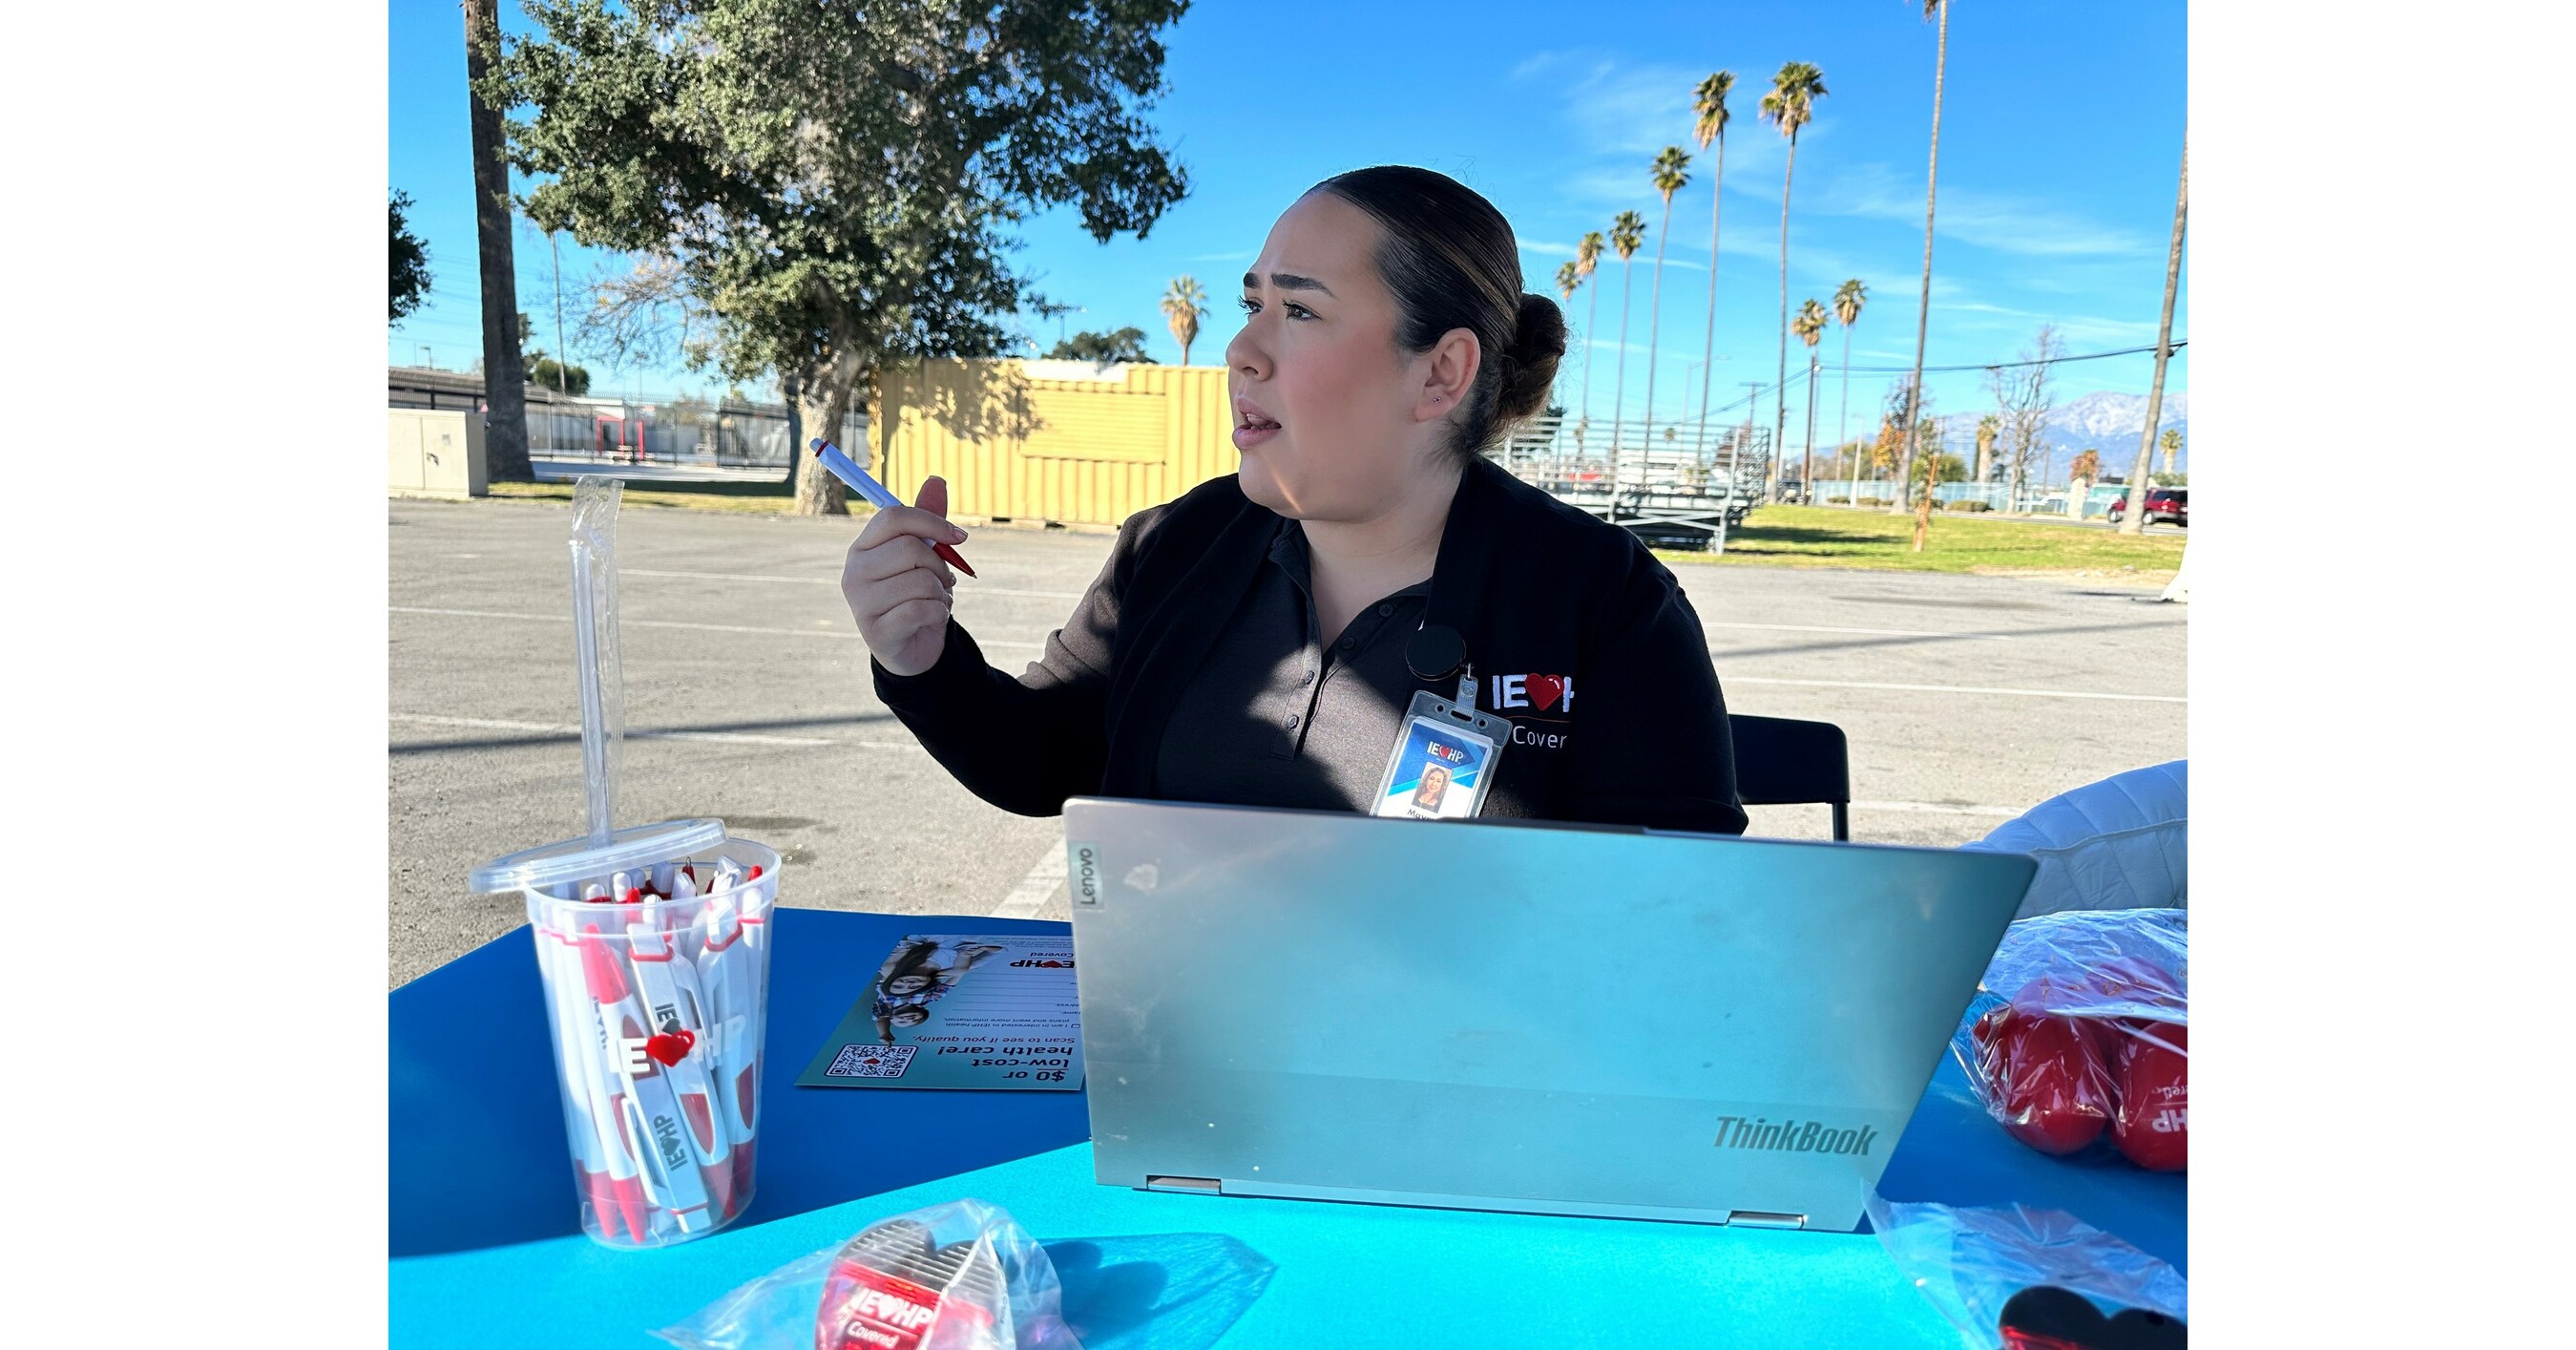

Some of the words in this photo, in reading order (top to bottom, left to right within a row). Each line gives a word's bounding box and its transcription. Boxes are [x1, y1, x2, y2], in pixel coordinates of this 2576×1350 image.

[1079, 847, 1097, 905] Lenovo
[912, 1035, 959, 1044] qualify.
[937, 1046, 995, 1056] care!
[1002, 1046, 1073, 1056] health
[972, 1059, 1070, 1068] low-cost
[1036, 1069, 1066, 1082] $0
[1713, 1116, 1878, 1155] ThinkBook
[847, 1320, 900, 1349] Covered
